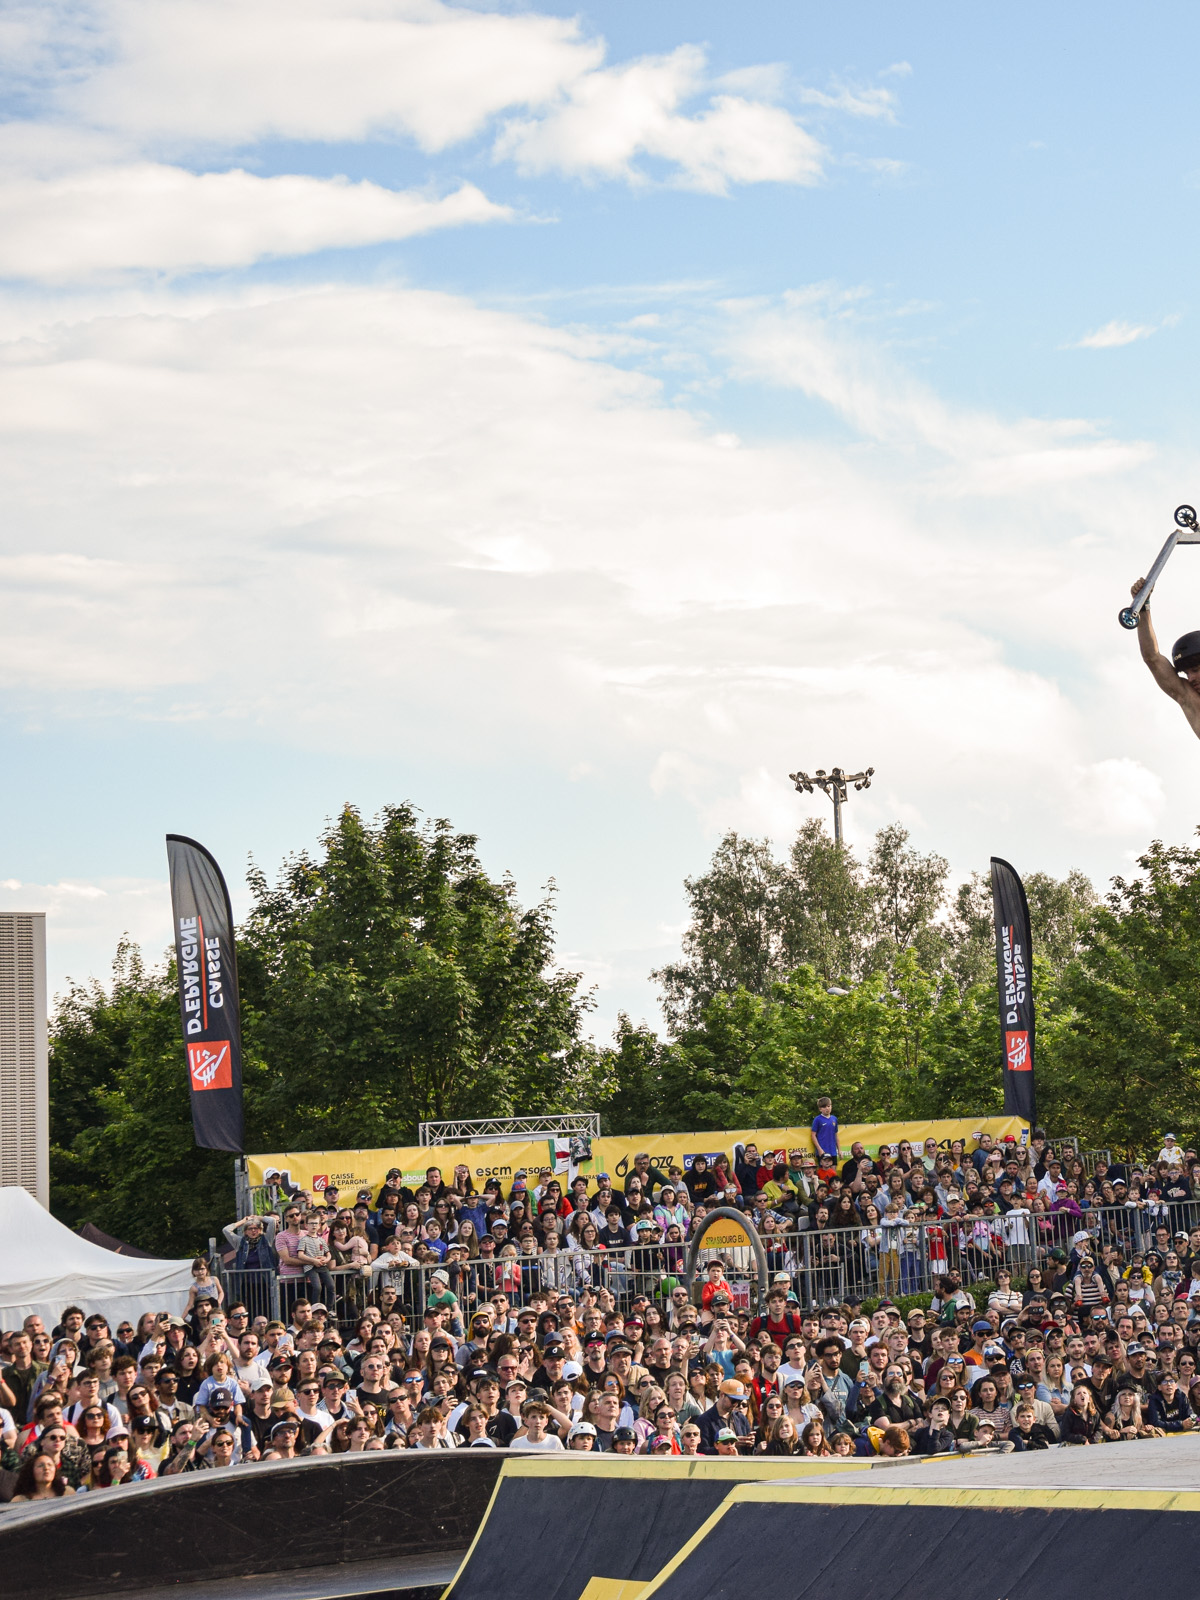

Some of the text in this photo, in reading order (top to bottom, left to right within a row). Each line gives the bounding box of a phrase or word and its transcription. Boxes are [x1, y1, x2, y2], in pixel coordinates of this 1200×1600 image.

[476, 1166, 512, 1177] escm
[331, 1178, 368, 1186] D'EPARGNE
[705, 1234, 737, 1245] STRASBOURG
